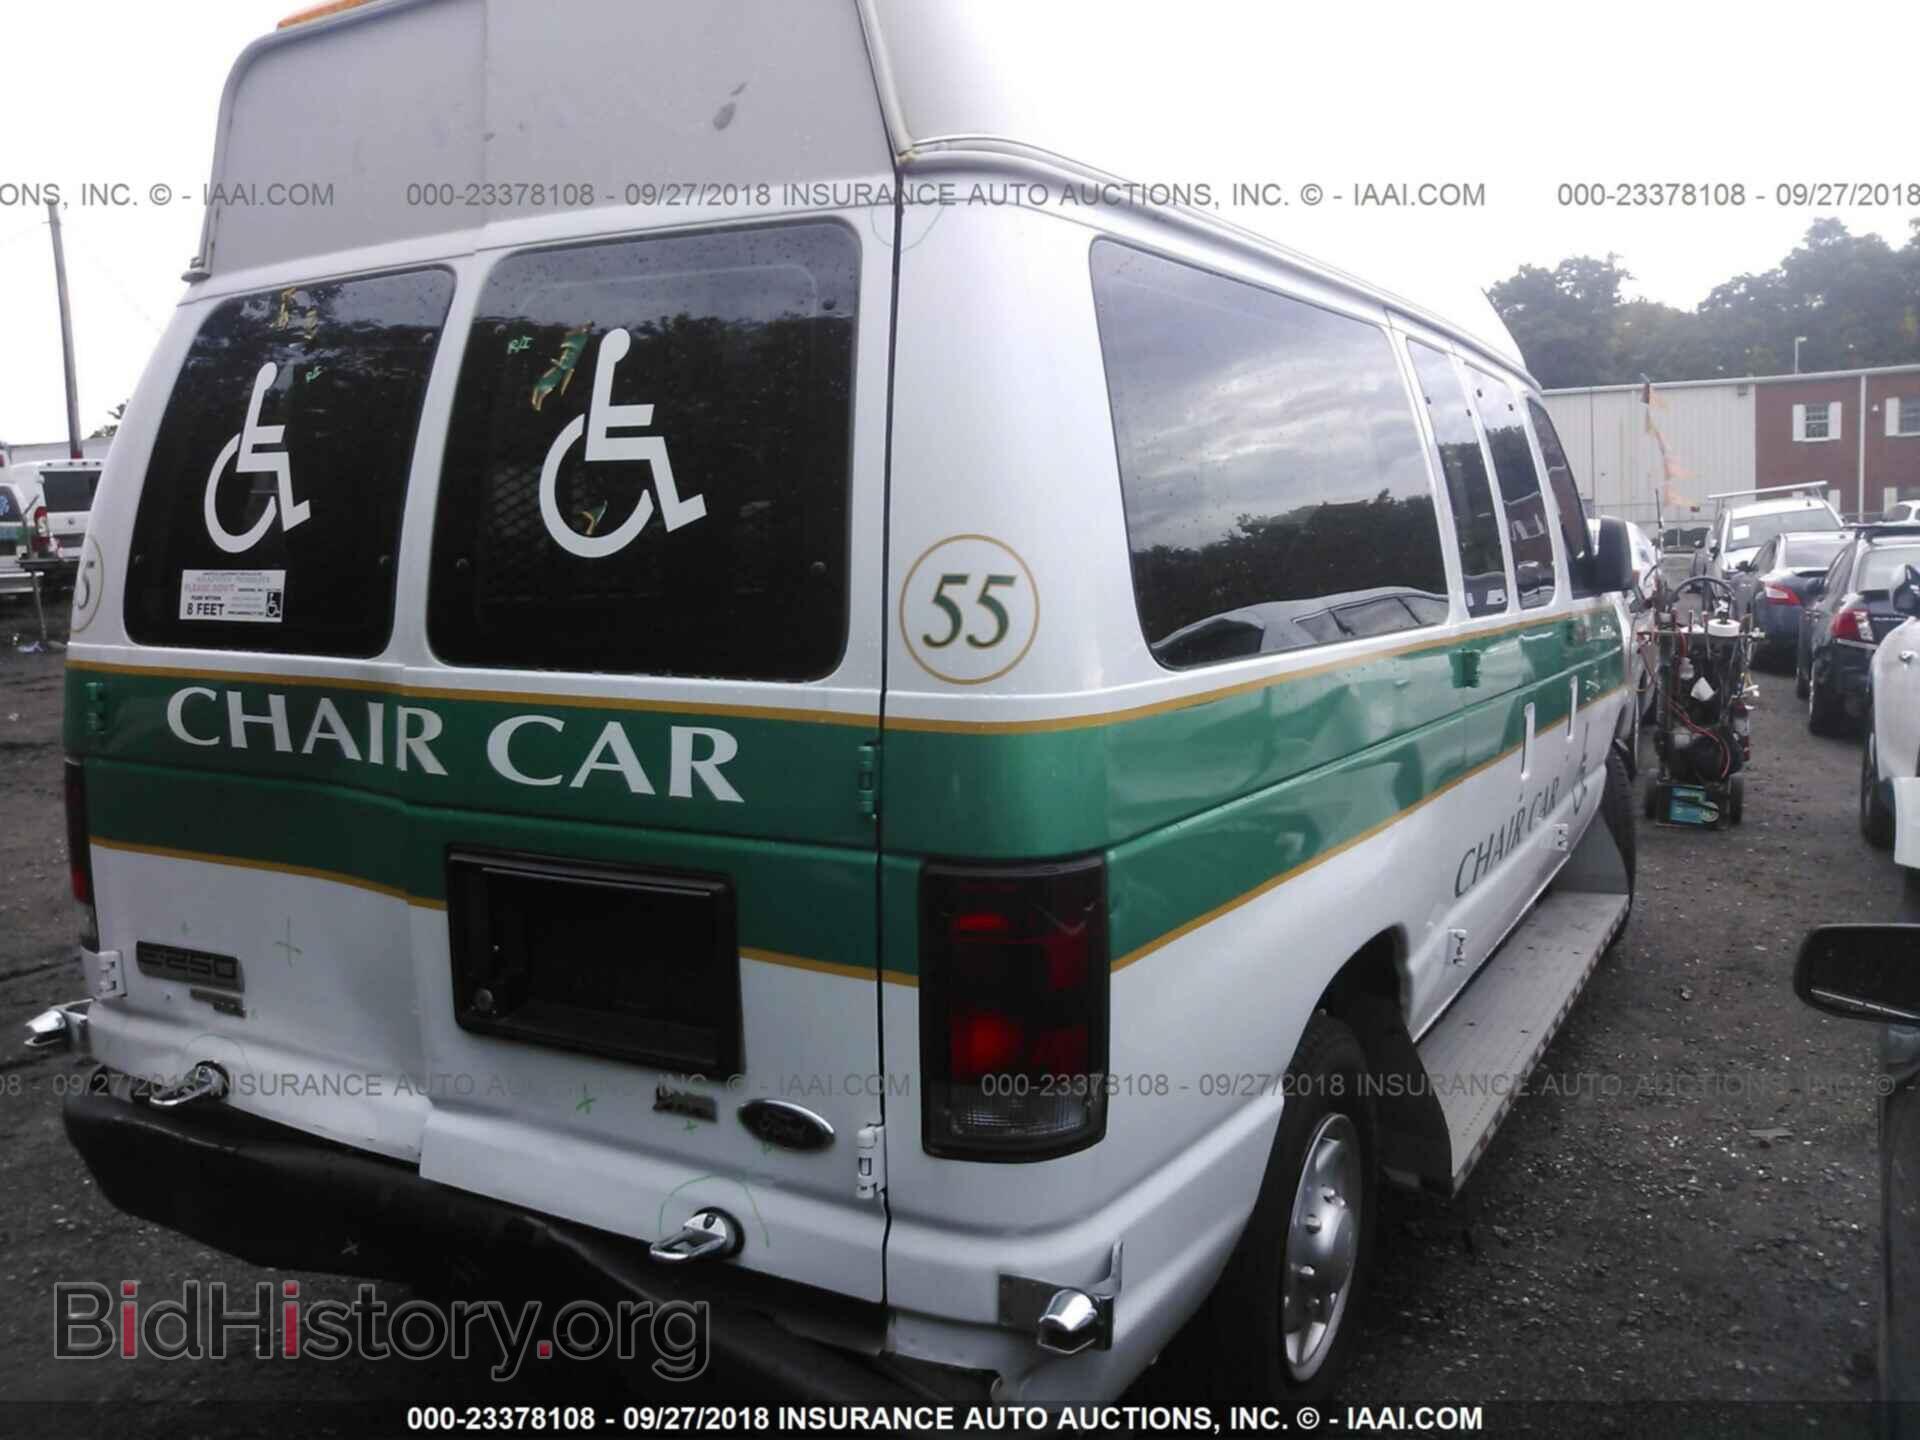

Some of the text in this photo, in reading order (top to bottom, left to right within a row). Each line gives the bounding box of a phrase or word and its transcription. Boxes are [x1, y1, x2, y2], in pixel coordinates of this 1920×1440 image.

[186, 602, 194, 616] 8
[196, 602, 225, 616] FEET
[921, 573, 1017, 650] 55
[166, 686, 745, 803] CHAIR CAR
[1454, 776, 1561, 898] CHAIR CAR
